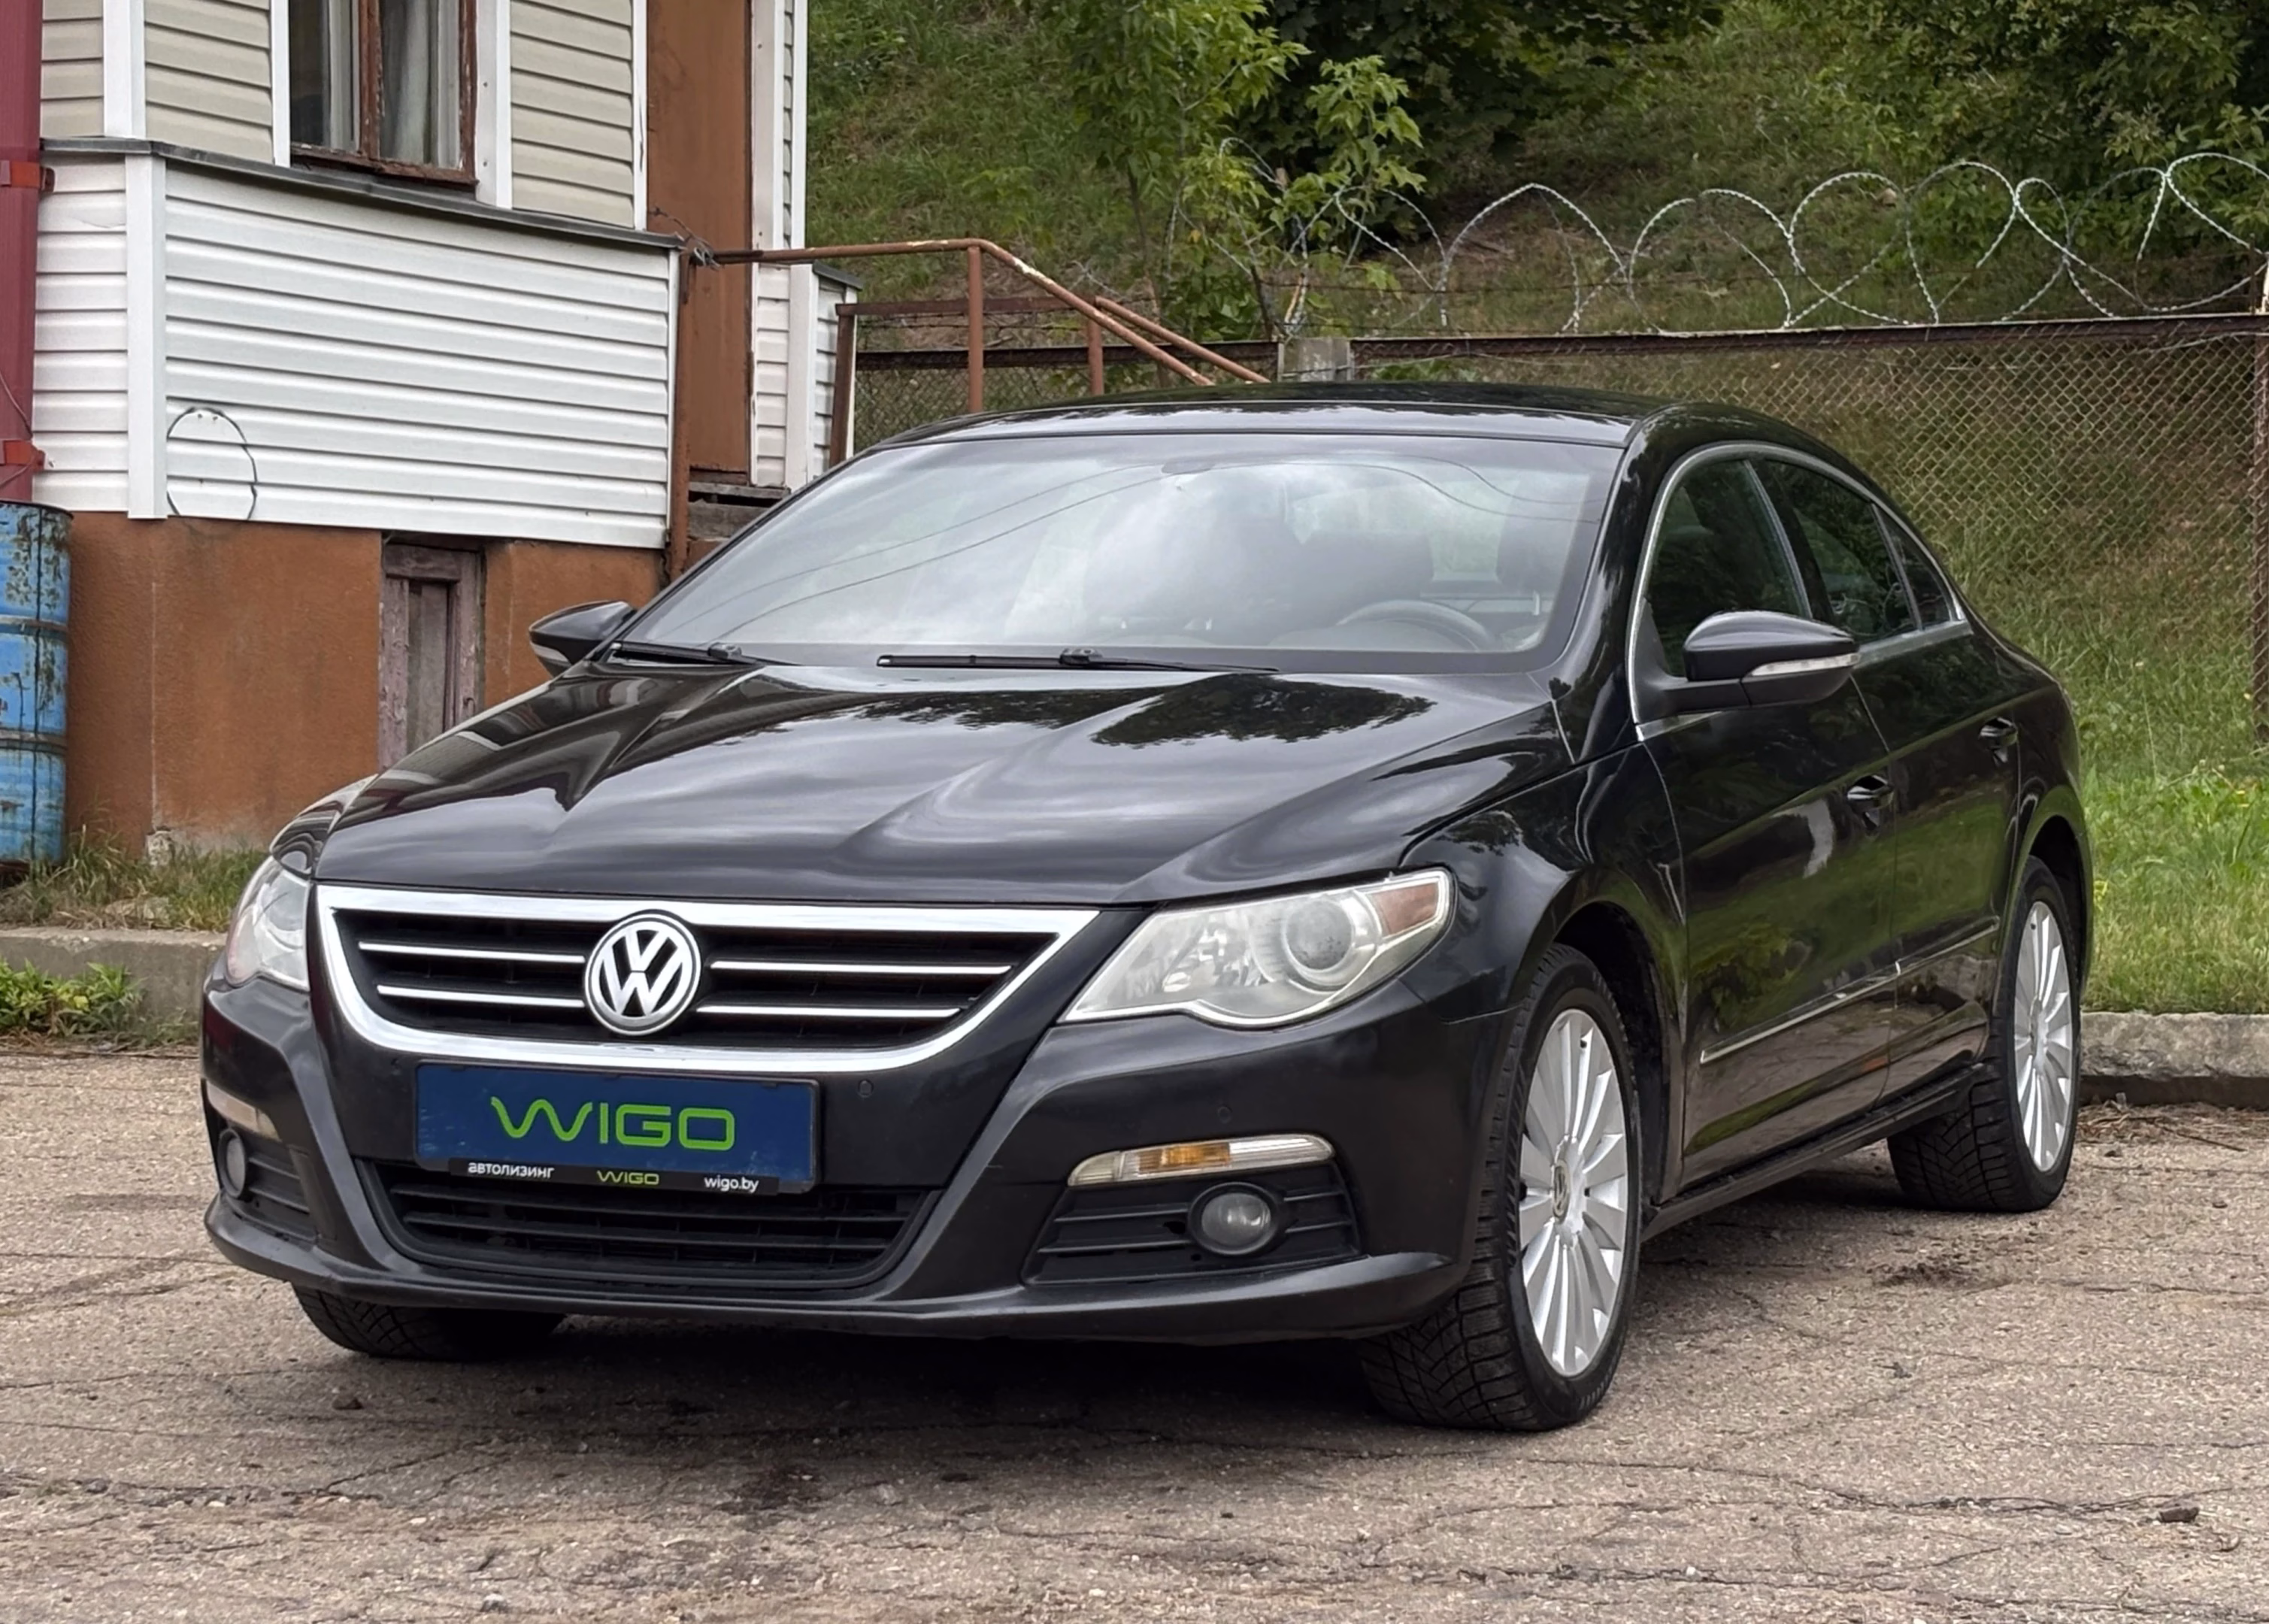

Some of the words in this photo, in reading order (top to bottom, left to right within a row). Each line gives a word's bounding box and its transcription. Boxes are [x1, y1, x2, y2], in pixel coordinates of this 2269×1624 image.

[490, 1095, 735, 1151] WIGO
[467, 1161, 555, 1180] автолизинг
[596, 1169, 660, 1186] WIGO
[704, 1175, 759, 1194] wigo.by
